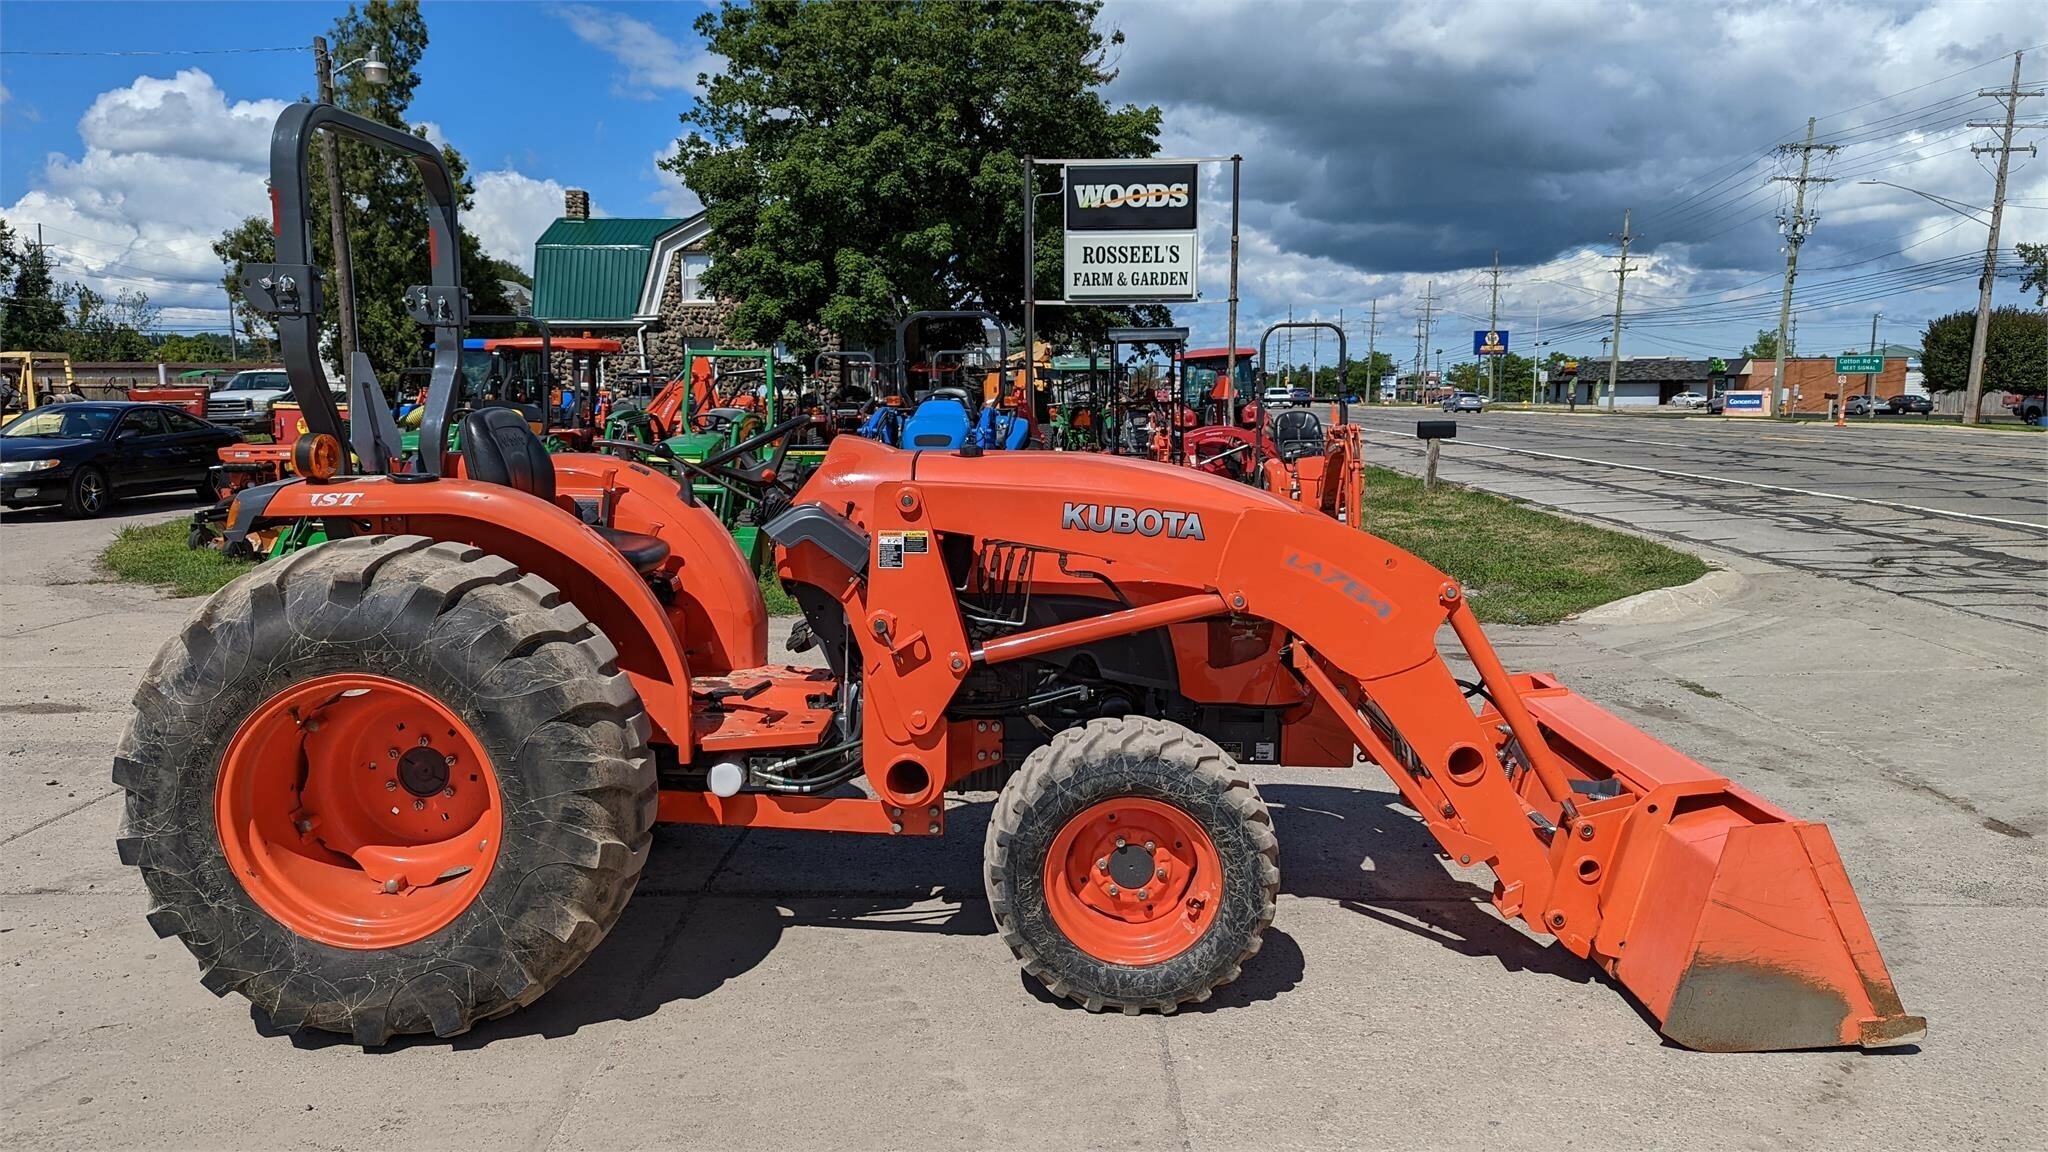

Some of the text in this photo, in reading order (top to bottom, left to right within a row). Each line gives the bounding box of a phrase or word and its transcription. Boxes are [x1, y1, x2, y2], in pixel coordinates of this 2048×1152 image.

[1073, 183, 1189, 208] WOODS
[1082, 245, 1180, 264] ROSSEEL'S
[1073, 271, 1189, 287] FARM & GARDEN
[1062, 501, 1205, 541] KUBOTA
